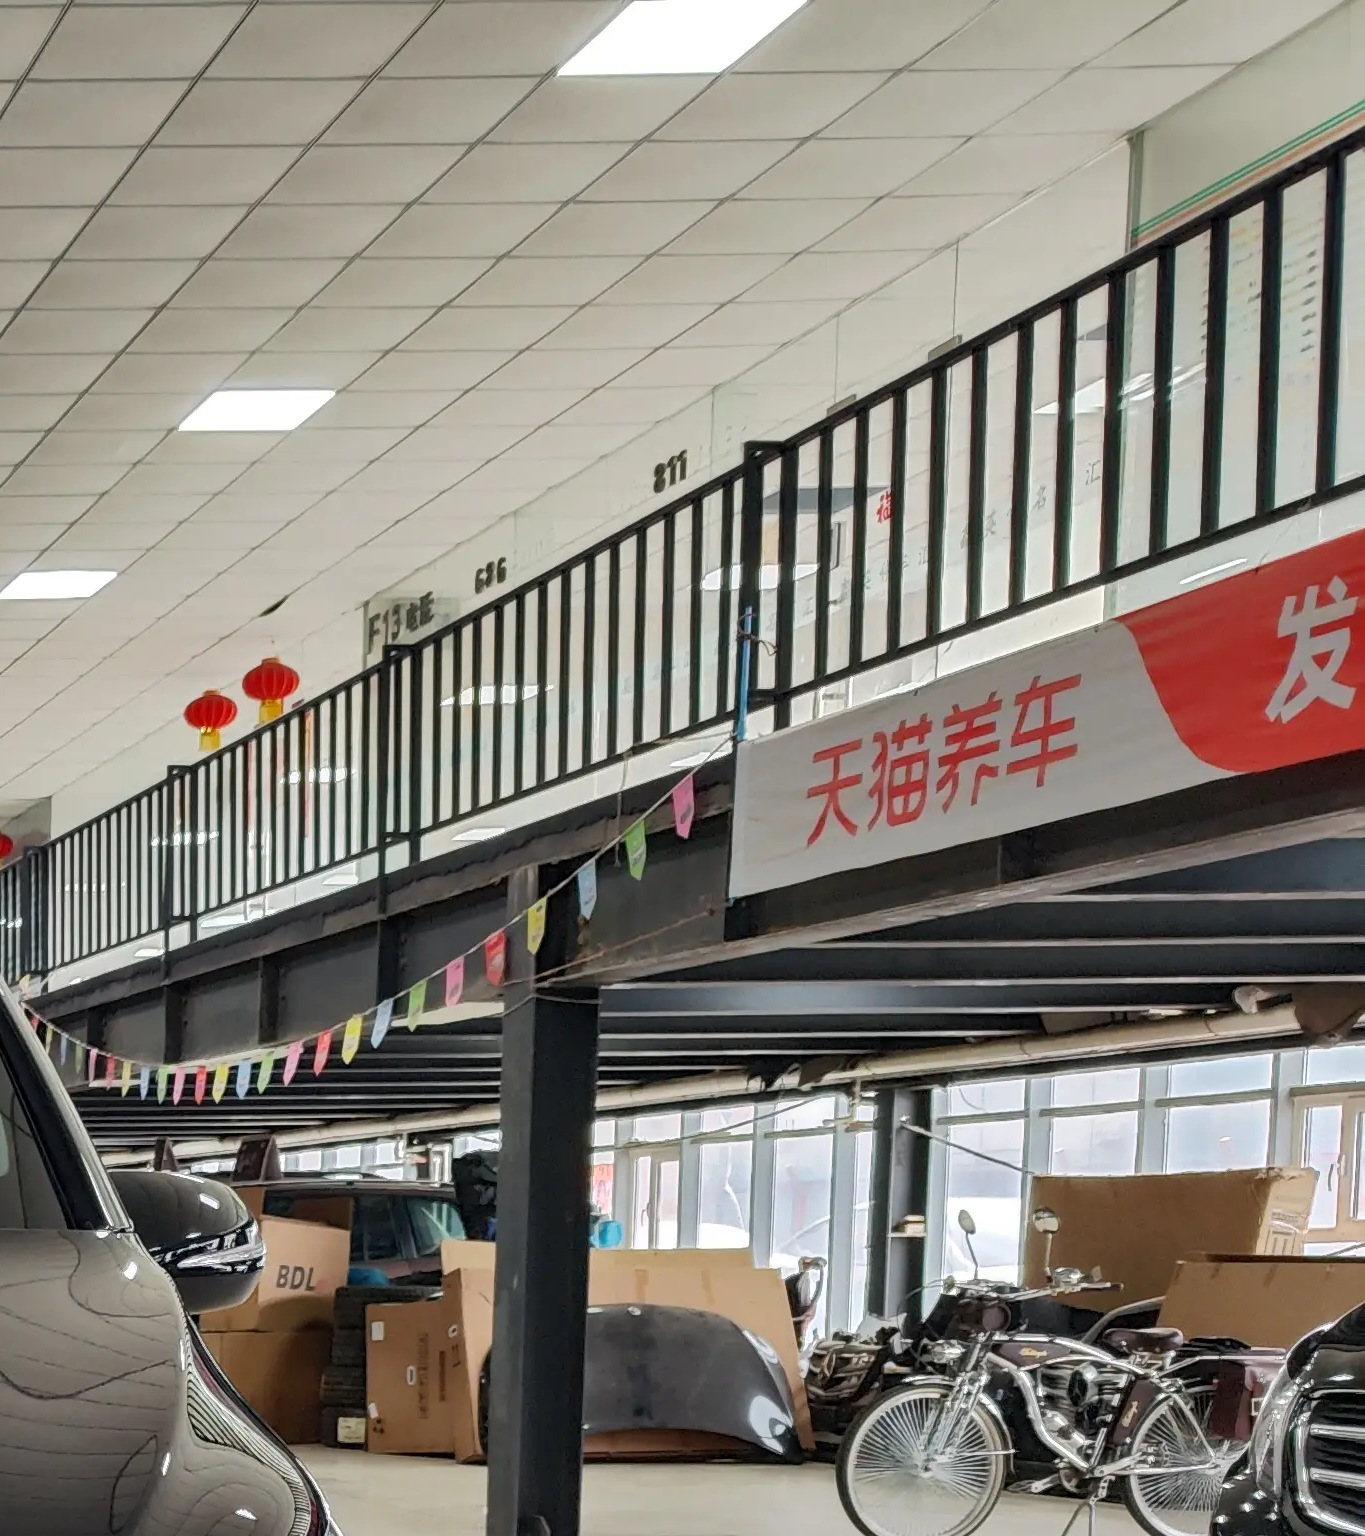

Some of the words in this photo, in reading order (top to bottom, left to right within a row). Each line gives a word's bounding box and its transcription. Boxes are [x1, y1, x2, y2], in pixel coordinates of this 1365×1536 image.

[1265, 575, 1358, 725] 发
[806, 673, 1082, 848] 天猫养车
[276, 1265, 317, 1291] BDL
